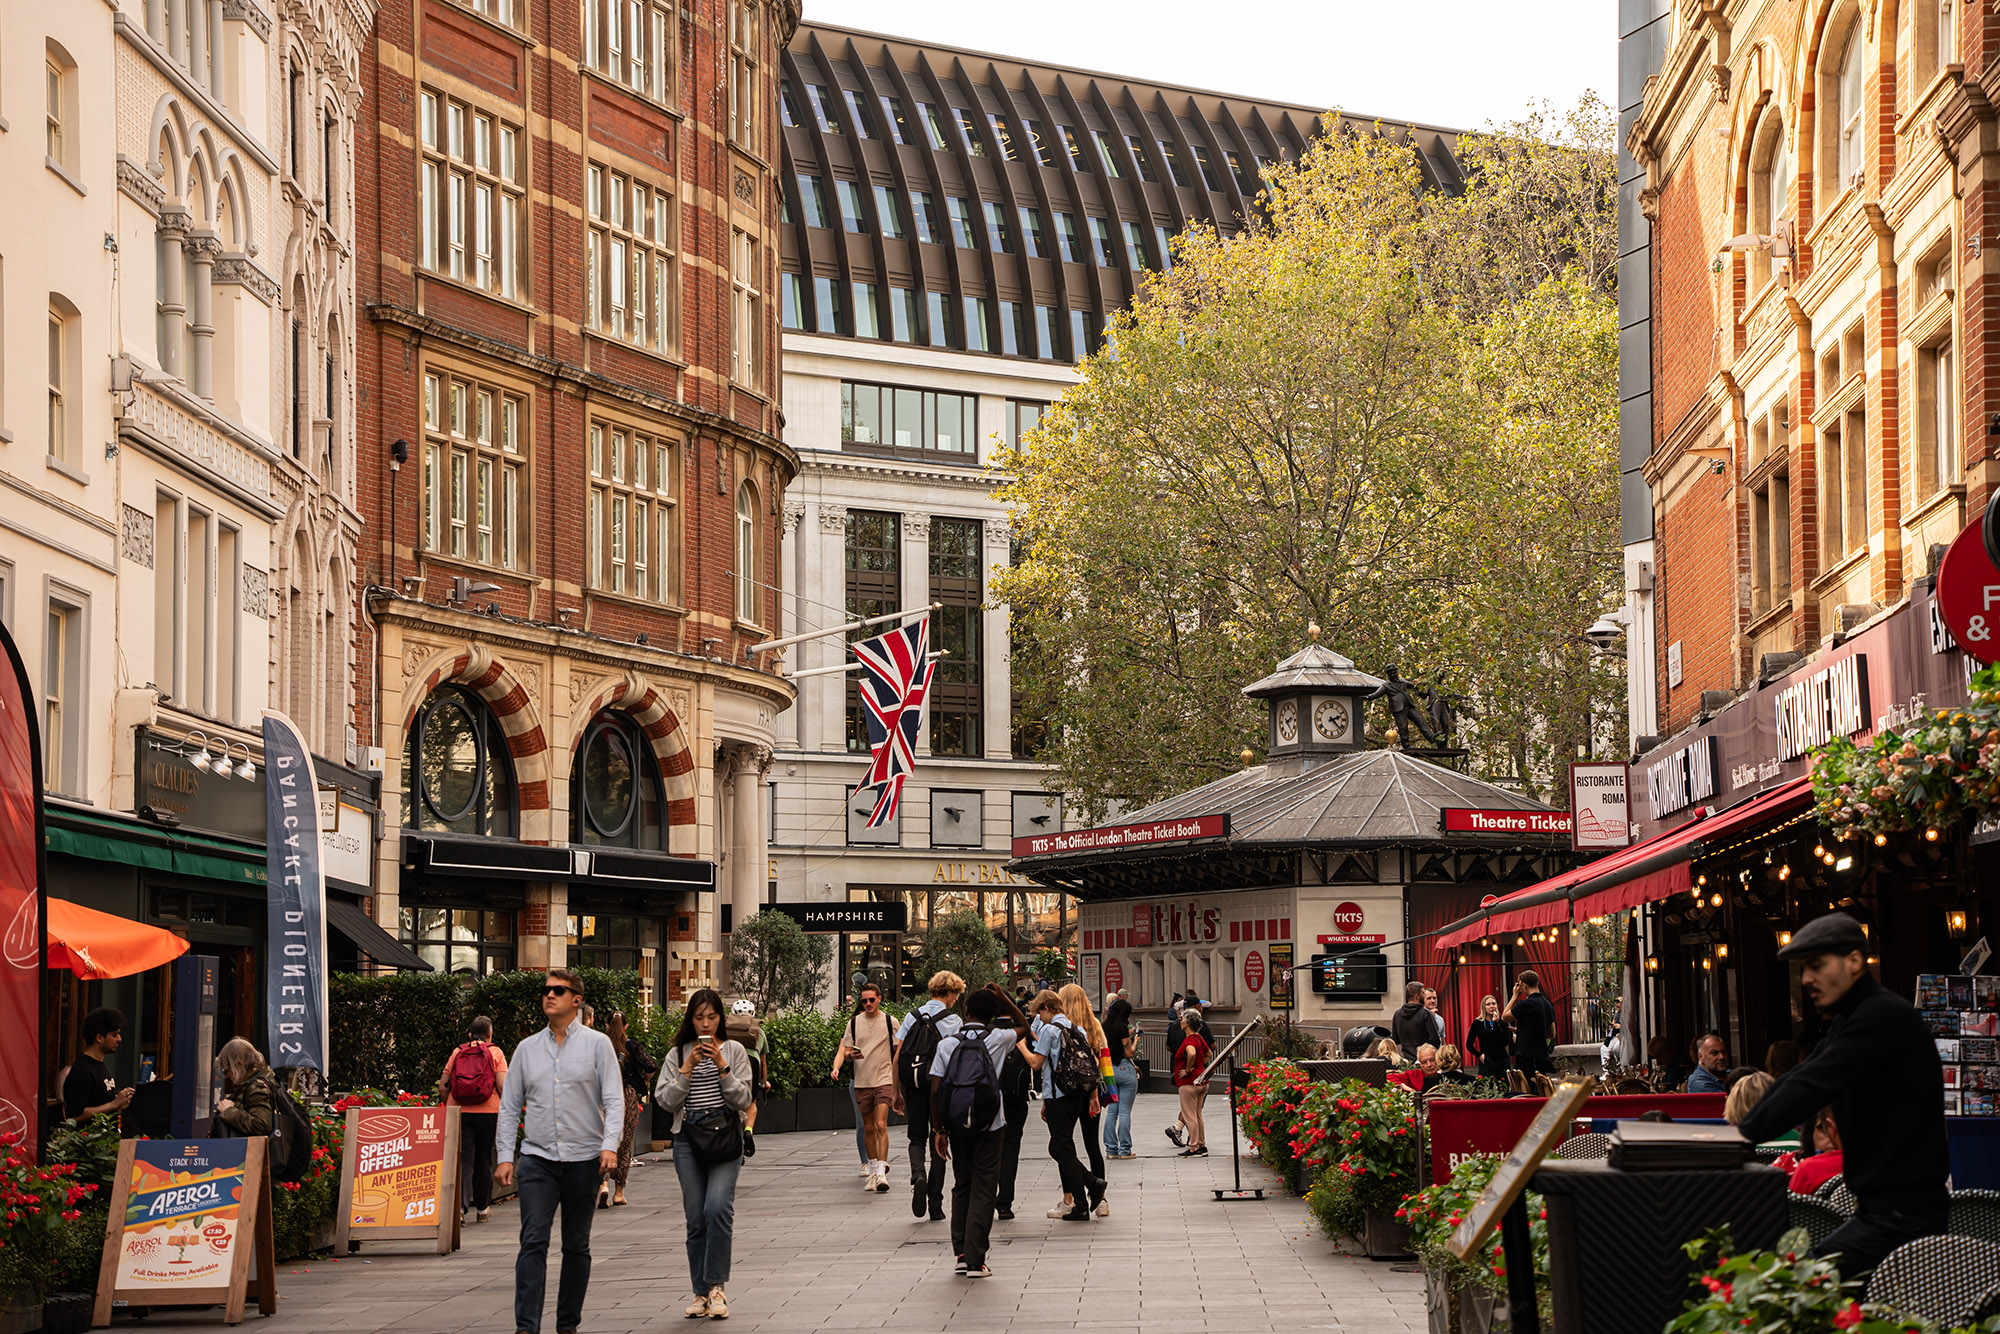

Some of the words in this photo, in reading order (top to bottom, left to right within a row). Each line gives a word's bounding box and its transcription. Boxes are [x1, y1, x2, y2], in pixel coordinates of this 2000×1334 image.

[1966, 615, 1991, 642] &
[1774, 668, 1832, 763] RISTORANTE
[1829, 653, 1863, 738] ROMA
[1576, 776, 1624, 787] RISTORANTE
[1646, 748, 1689, 821] RISTORANTE
[1687, 736, 1714, 803] ROMA
[1602, 793, 1625, 804] ROMA
[1470, 813, 1527, 830] Theatre
[1529, 814, 1571, 831] Ticket
[1031, 839, 1049, 853] TKTS
[1055, 836, 1068, 850] The
[1068, 832, 1095, 849] Official
[1095, 832, 1123, 846] London
[1123, 828, 1152, 843] Theatre
[1153, 824, 1176, 839] Ticket
[1177, 821, 1201, 837] Booth
[806, 911, 884, 921] HAMPSHIRE
[1155, 902, 1219, 943] tkts
[1334, 912, 1363, 923] TKTS
[360, 1137, 412, 1159] SPECIAL
[169, 1157, 188, 1167] STACK
[193, 1157, 209, 1167] STILL
[359, 1153, 404, 1174] OFFER:
[371, 1173, 394, 1188] ANY
[396, 1164, 437, 1183] BURGER
[396, 1179, 419, 1189] WAFFLE
[419, 1176, 437, 1185] FRIES
[397, 1183, 436, 1196] BOTTOMLESS
[401, 1193, 416, 1203] SOFT
[417, 1190, 436, 1200] DRINK
[148, 1182, 220, 1217] APEROL
[165, 1202, 197, 1215] TERRACE
[404, 1198, 436, 1220] £15
[126, 1236, 162, 1252] APEROL
[131, 1246, 156, 1257] SPRITZ
[133, 1268, 146, 1276] Full
[146, 1269, 167, 1277] Drinks
[188, 1263, 219, 1274] Available
